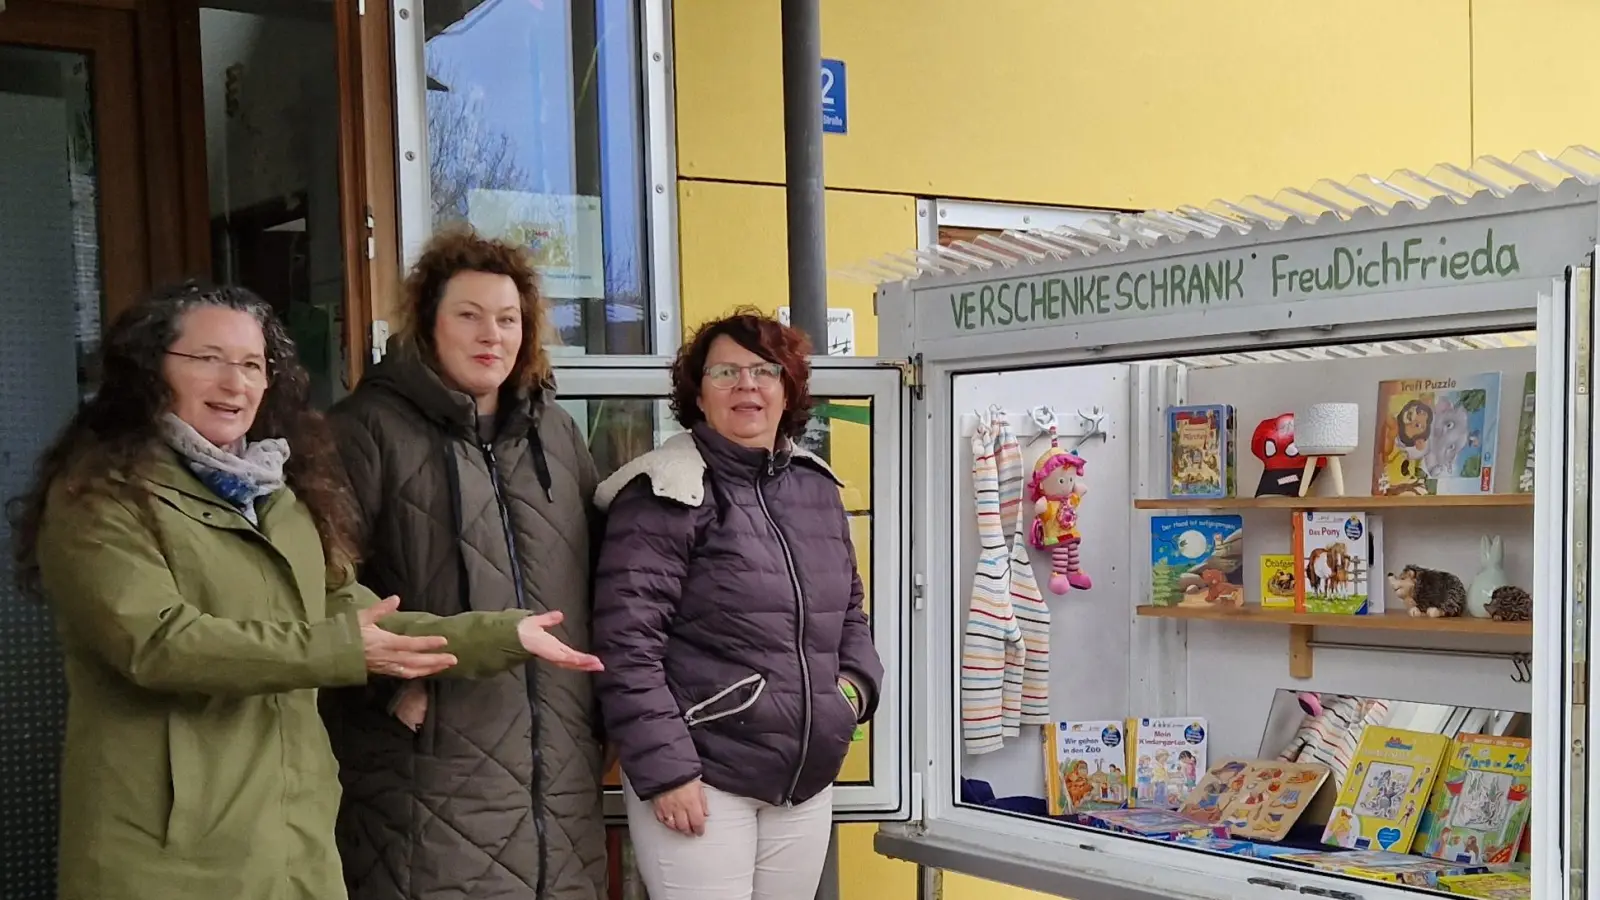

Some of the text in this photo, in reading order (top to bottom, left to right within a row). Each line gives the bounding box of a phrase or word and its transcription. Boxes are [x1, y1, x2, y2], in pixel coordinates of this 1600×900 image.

[950, 228, 1520, 330] VERSCHENKESCHRANK FreuDichFrieda
[1425, 377, 1457, 390] Puzzle
[1161, 524, 1172, 532] Der
[1309, 528, 1321, 536] Das
[1321, 527, 1340, 538] Pony
[1153, 730, 1171, 738] Mein
[1064, 737, 1077, 745] Wir
[1078, 737, 1099, 746] gehen
[1138, 738, 1186, 747] Kindergarten
[1085, 745, 1102, 753] Zoo
[1503, 753, 1525, 772] Zoo
